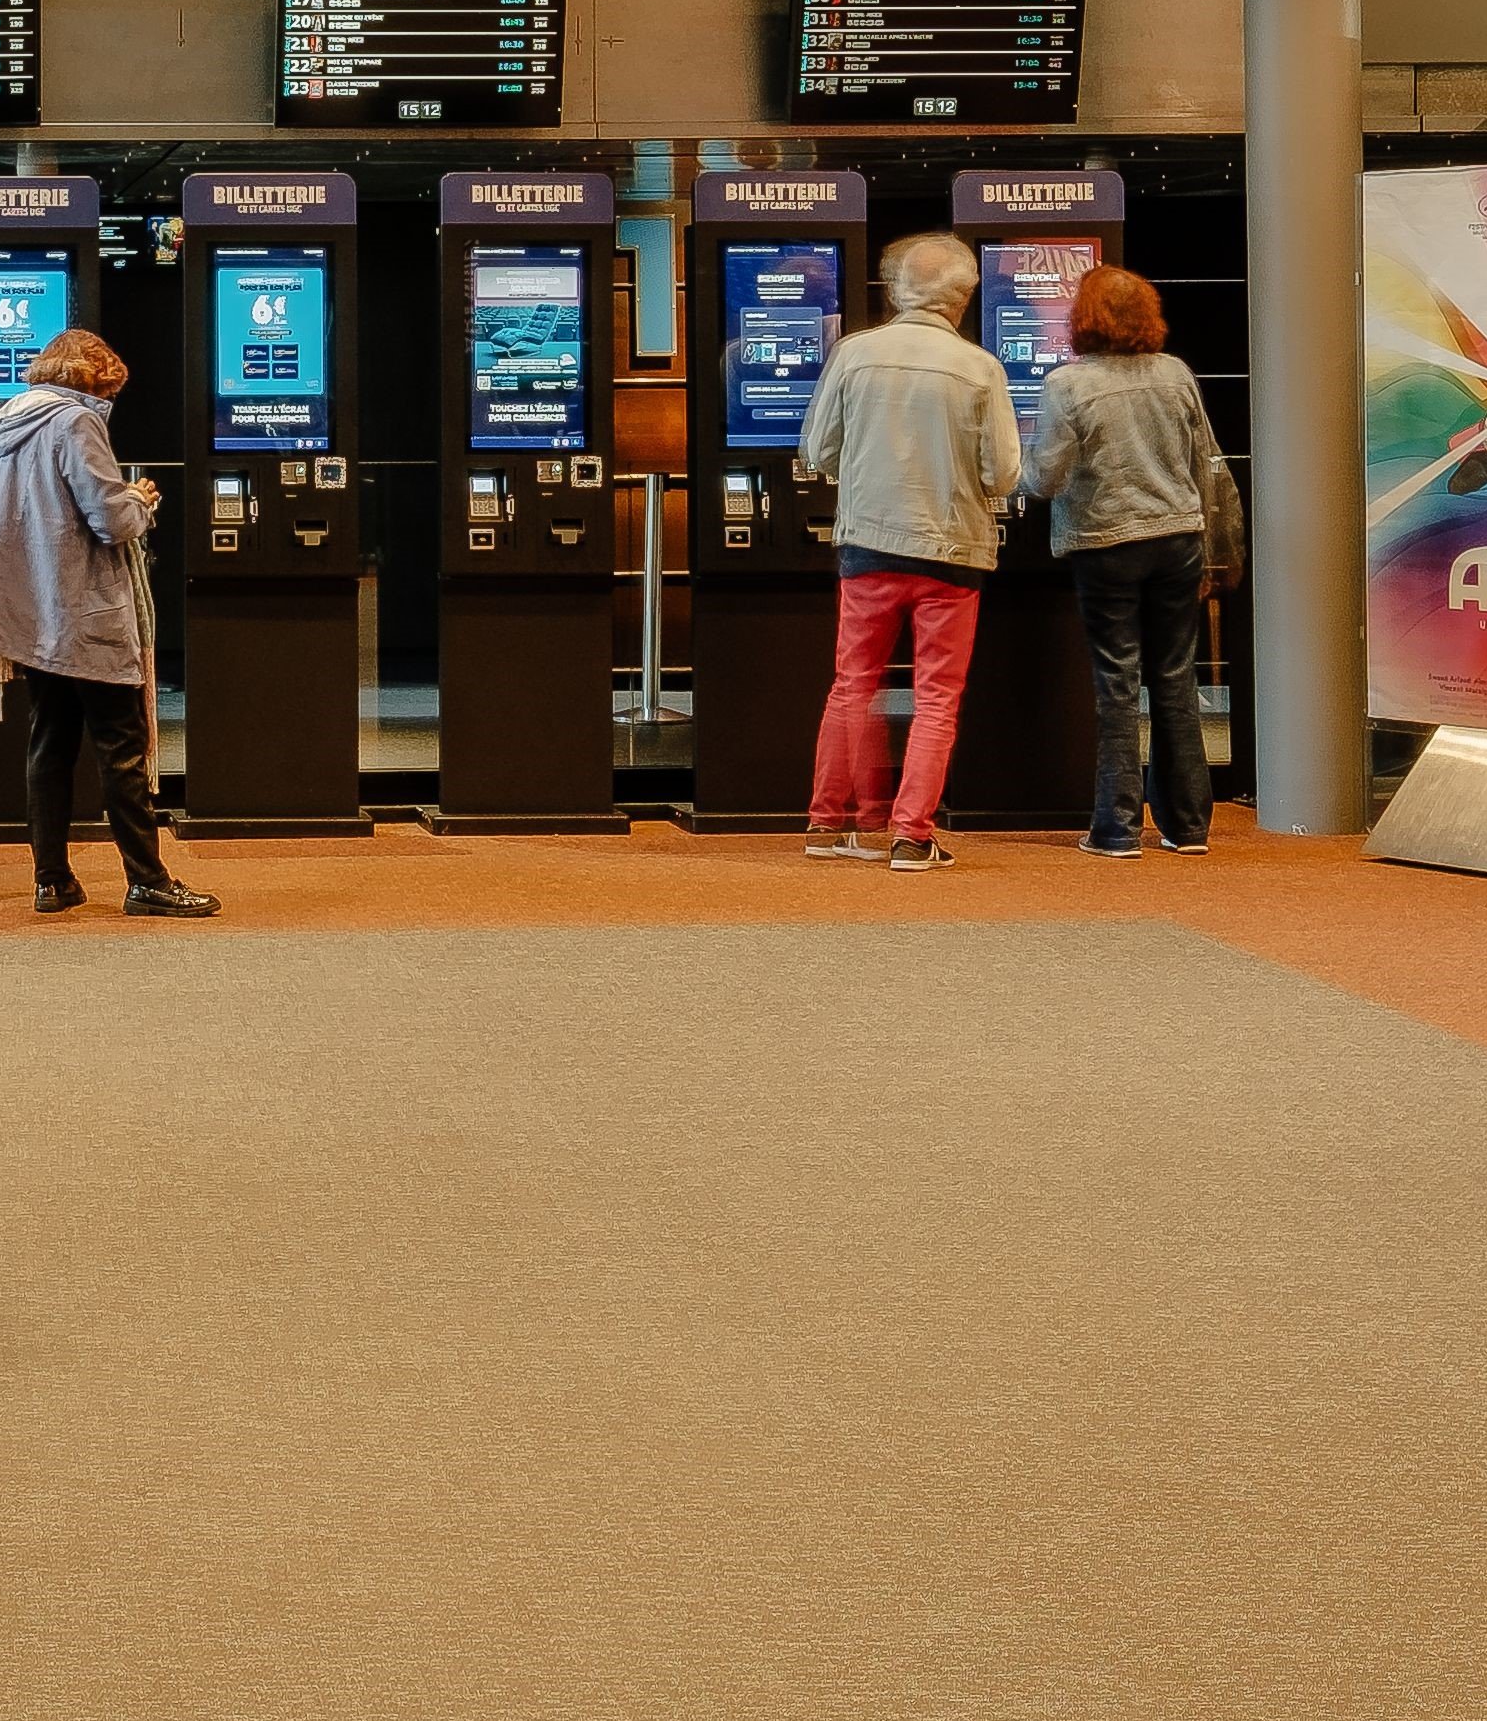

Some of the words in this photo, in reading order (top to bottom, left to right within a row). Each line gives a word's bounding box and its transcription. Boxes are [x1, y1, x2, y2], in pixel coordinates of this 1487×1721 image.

[292, 15, 310, 29] 20
[810, 13, 829, 25] 31
[291, 37, 310, 51] 21
[808, 35, 828, 48] 32
[290, 60, 310, 73] 22
[807, 57, 826, 70] 33
[289, 81, 310, 95] 23
[806, 79, 826, 92] 34
[401, 103, 419, 117] 15
[423, 103, 441, 117] 12
[916, 101, 934, 113] 15
[937, 101, 955, 113] 12
[213, 186, 326, 204] BILLETTERIE
[472, 184, 583, 203] BILLETTERIE
[726, 183, 837, 201] BILLETTERIE
[983, 183, 1094, 202] BILLETTERIE
[233, 405, 272, 413] TOUCHEZ
[274, 403, 309, 413] L'ÉCRAN
[232, 415, 256, 424] POUR
[257, 415, 310, 424] COMMENCER
